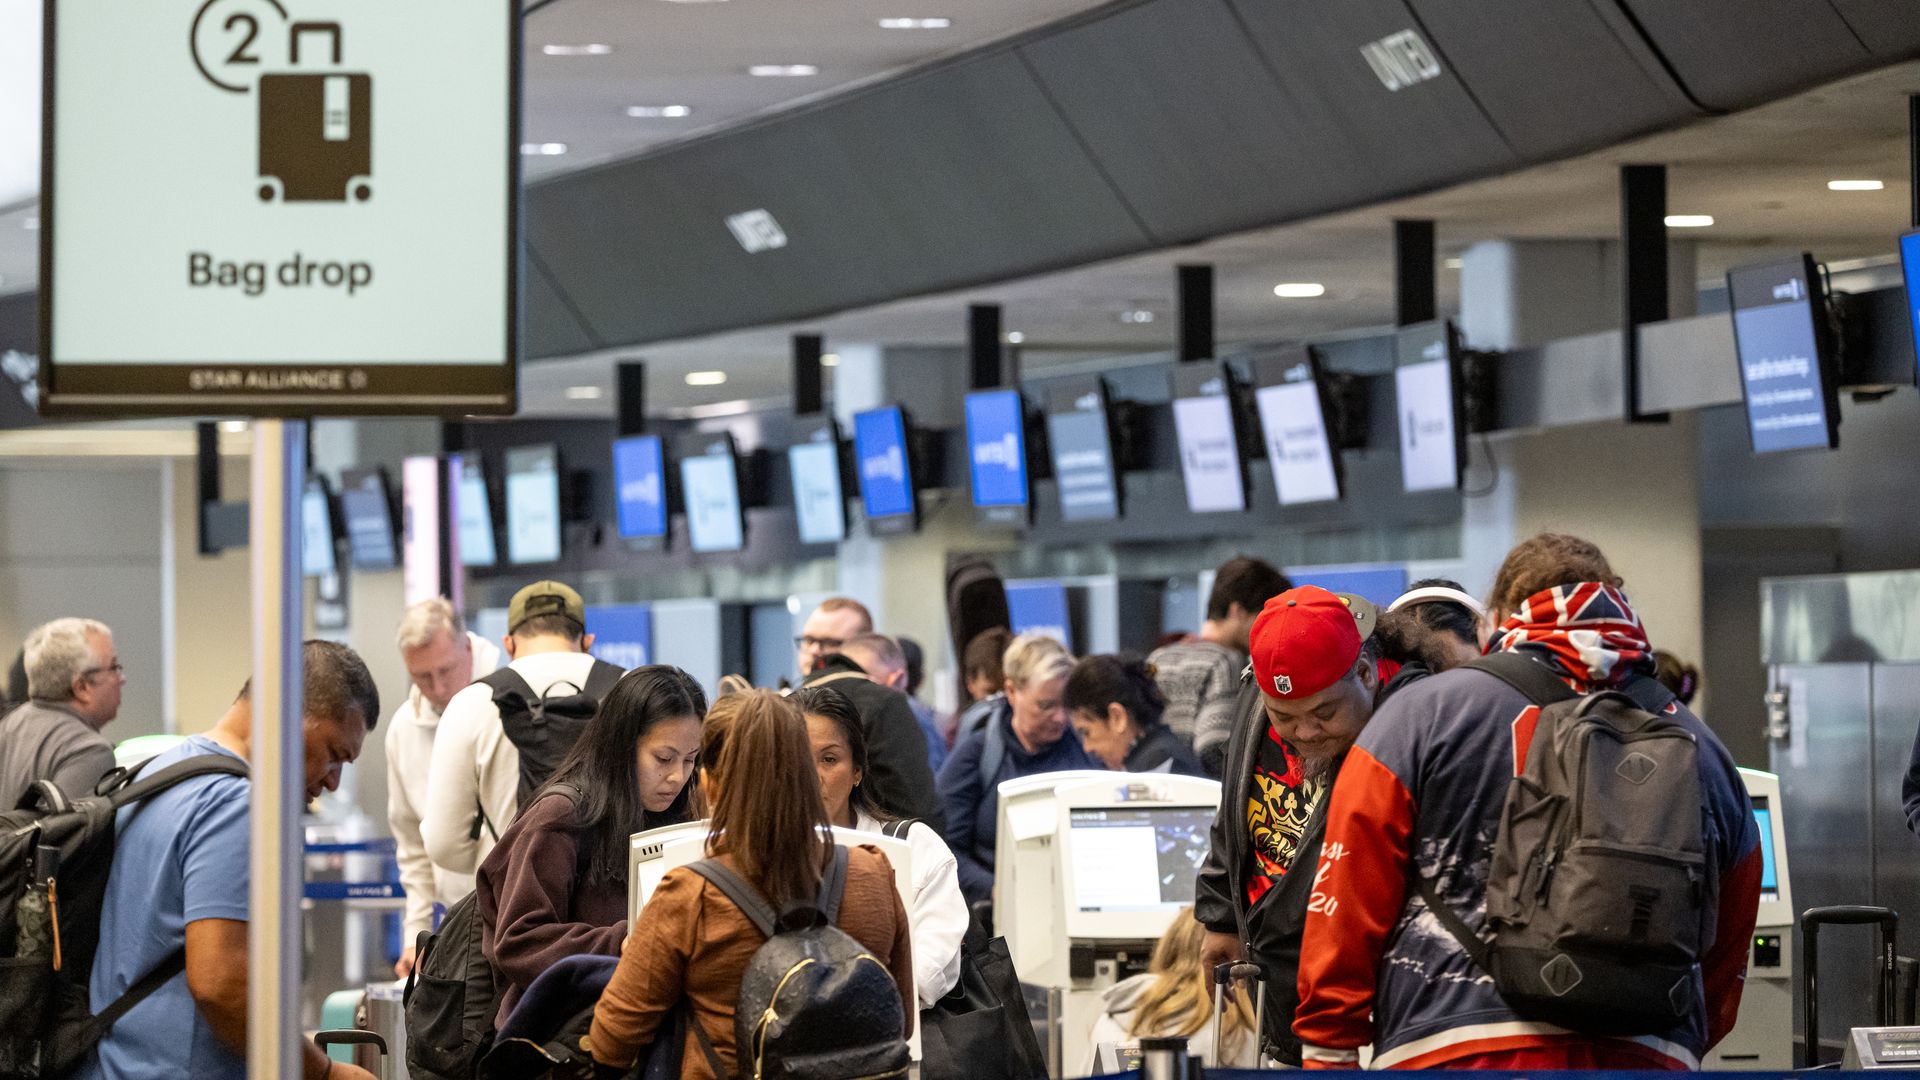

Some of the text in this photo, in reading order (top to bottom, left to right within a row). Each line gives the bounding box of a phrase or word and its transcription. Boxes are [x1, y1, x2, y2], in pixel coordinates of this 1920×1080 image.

[224, 12, 259, 64] 2
[188, 251, 374, 296] Bag drop
[189, 369, 345, 390] STAR ALLIANCE
